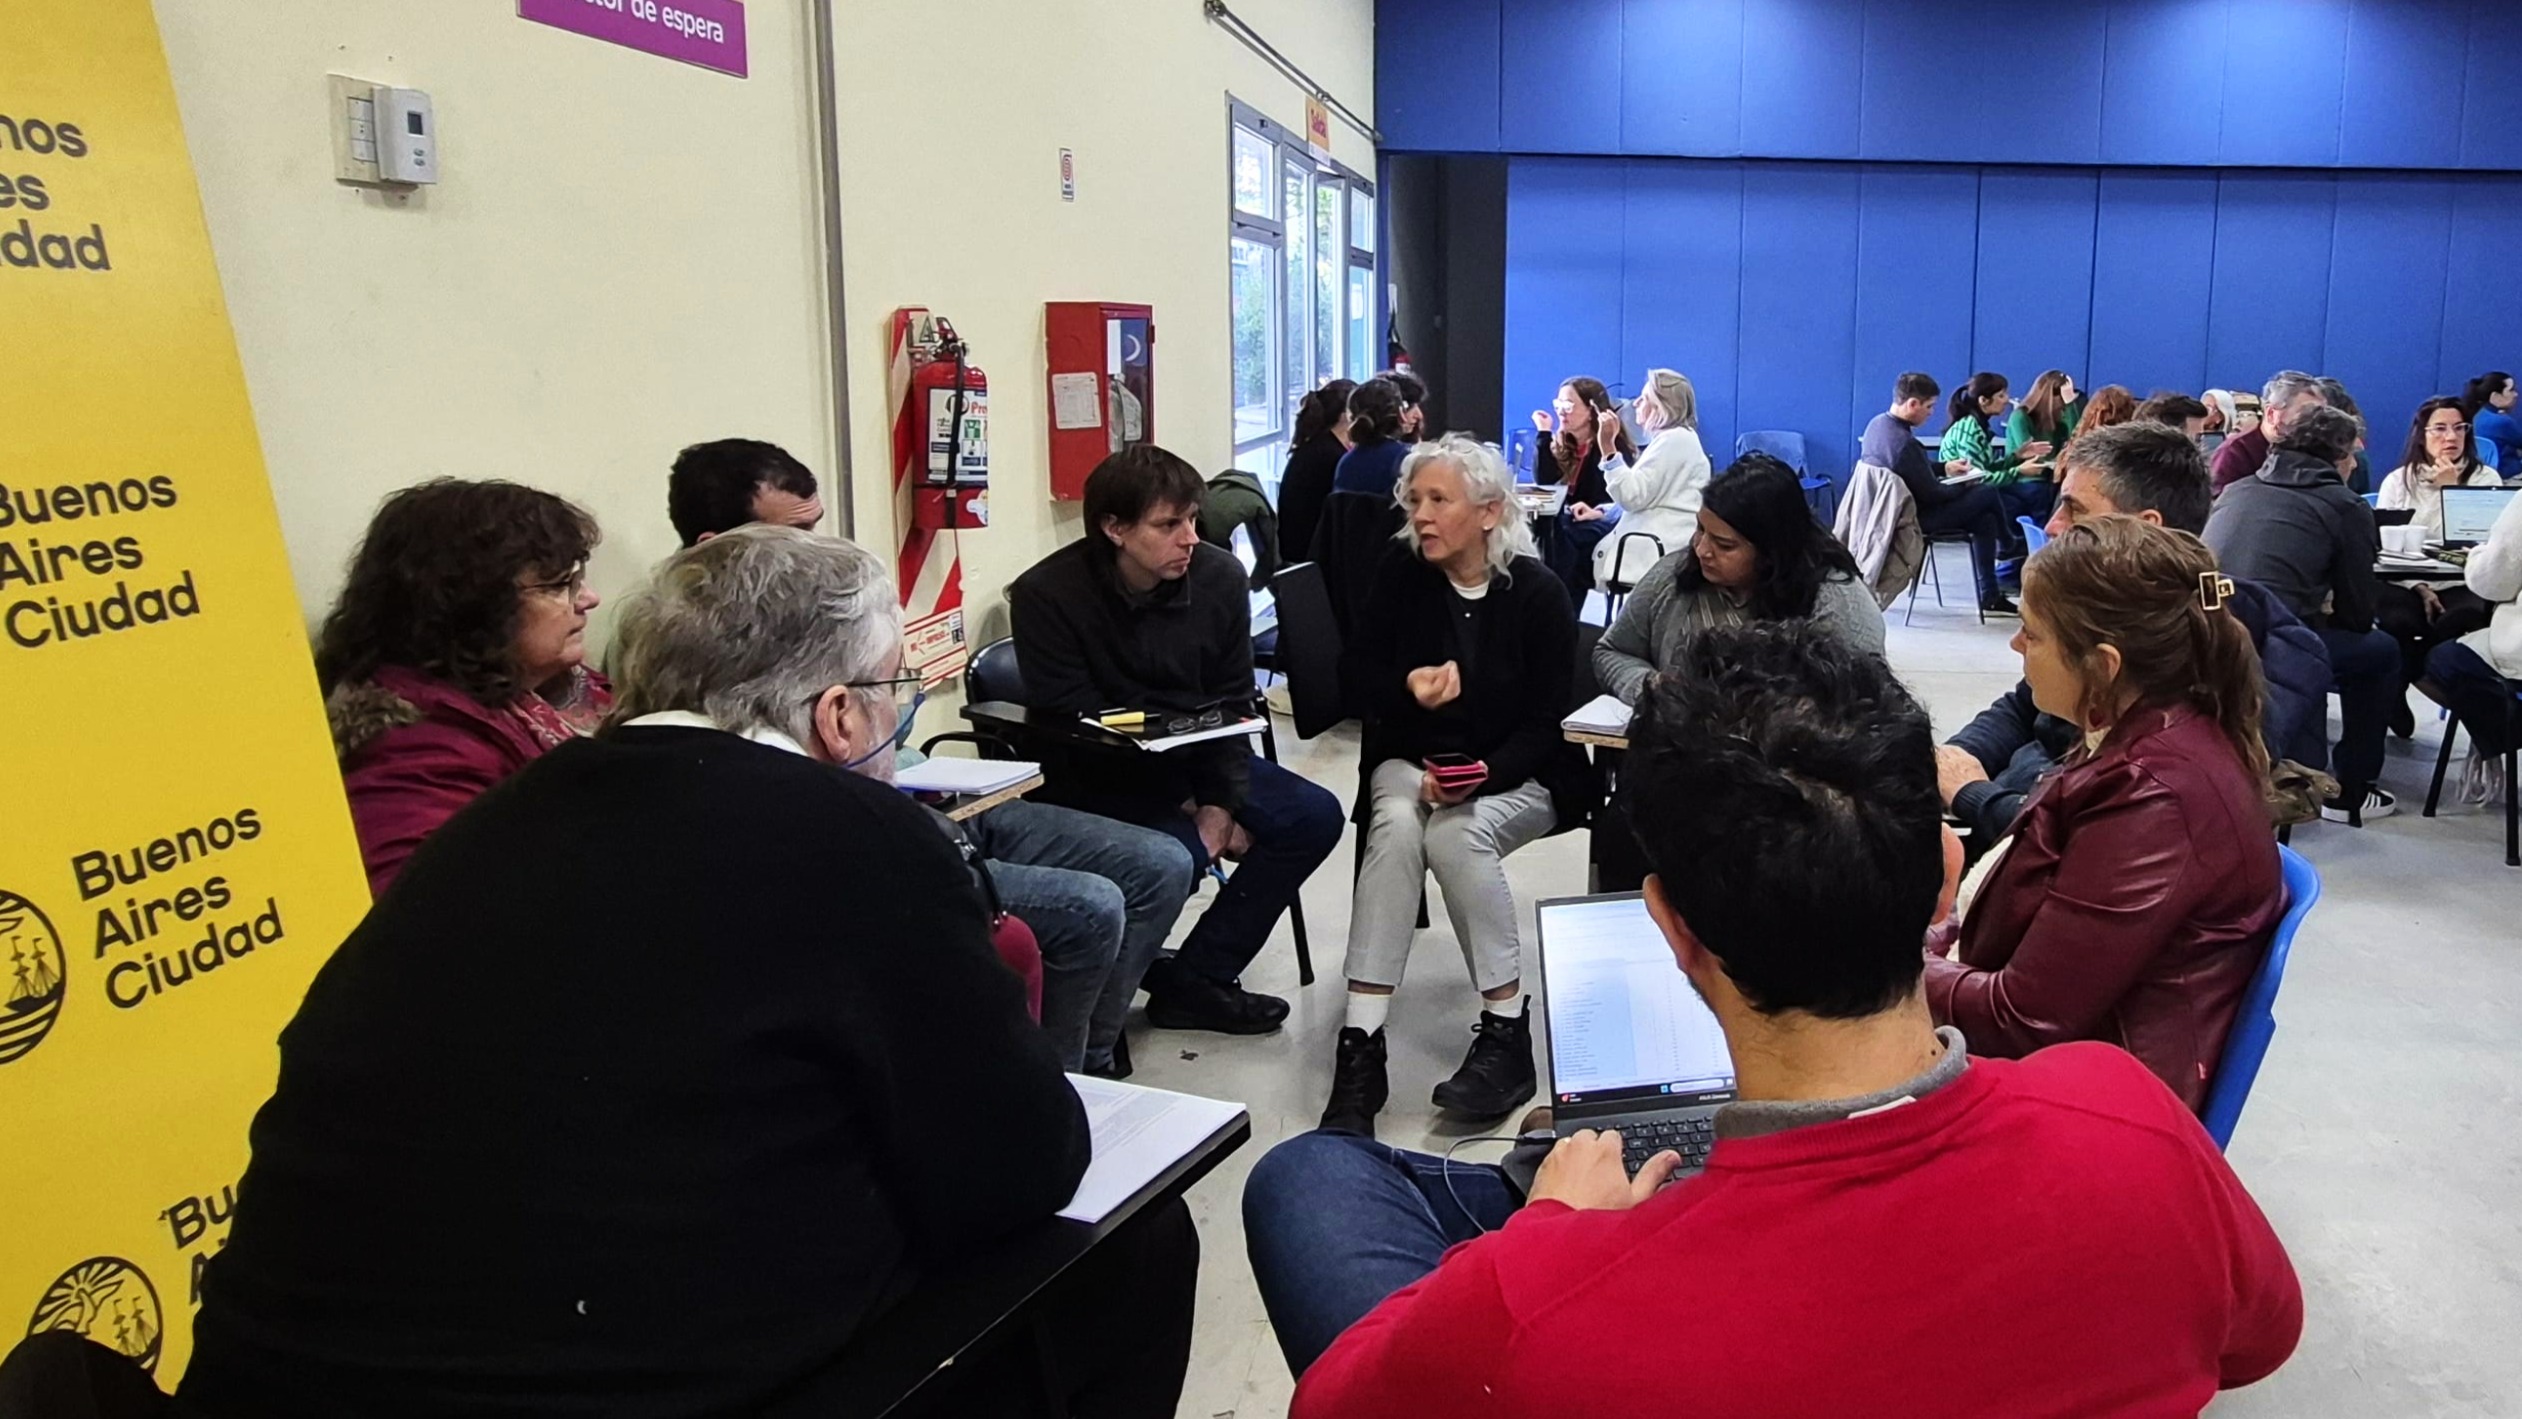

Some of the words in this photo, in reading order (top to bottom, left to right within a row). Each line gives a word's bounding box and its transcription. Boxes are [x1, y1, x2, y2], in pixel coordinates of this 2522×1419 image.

[631, 0, 657, 22] de
[662, 6, 724, 44] espera
[0, 114, 88, 158] nos
[0, 218, 112, 271] dad
[0, 536, 143, 591] Aires
[5, 570, 200, 648] Ciudad
[71, 808, 261, 901] Buenos
[95, 876, 231, 960] Aires
[105, 897, 285, 1009] Ciudad
